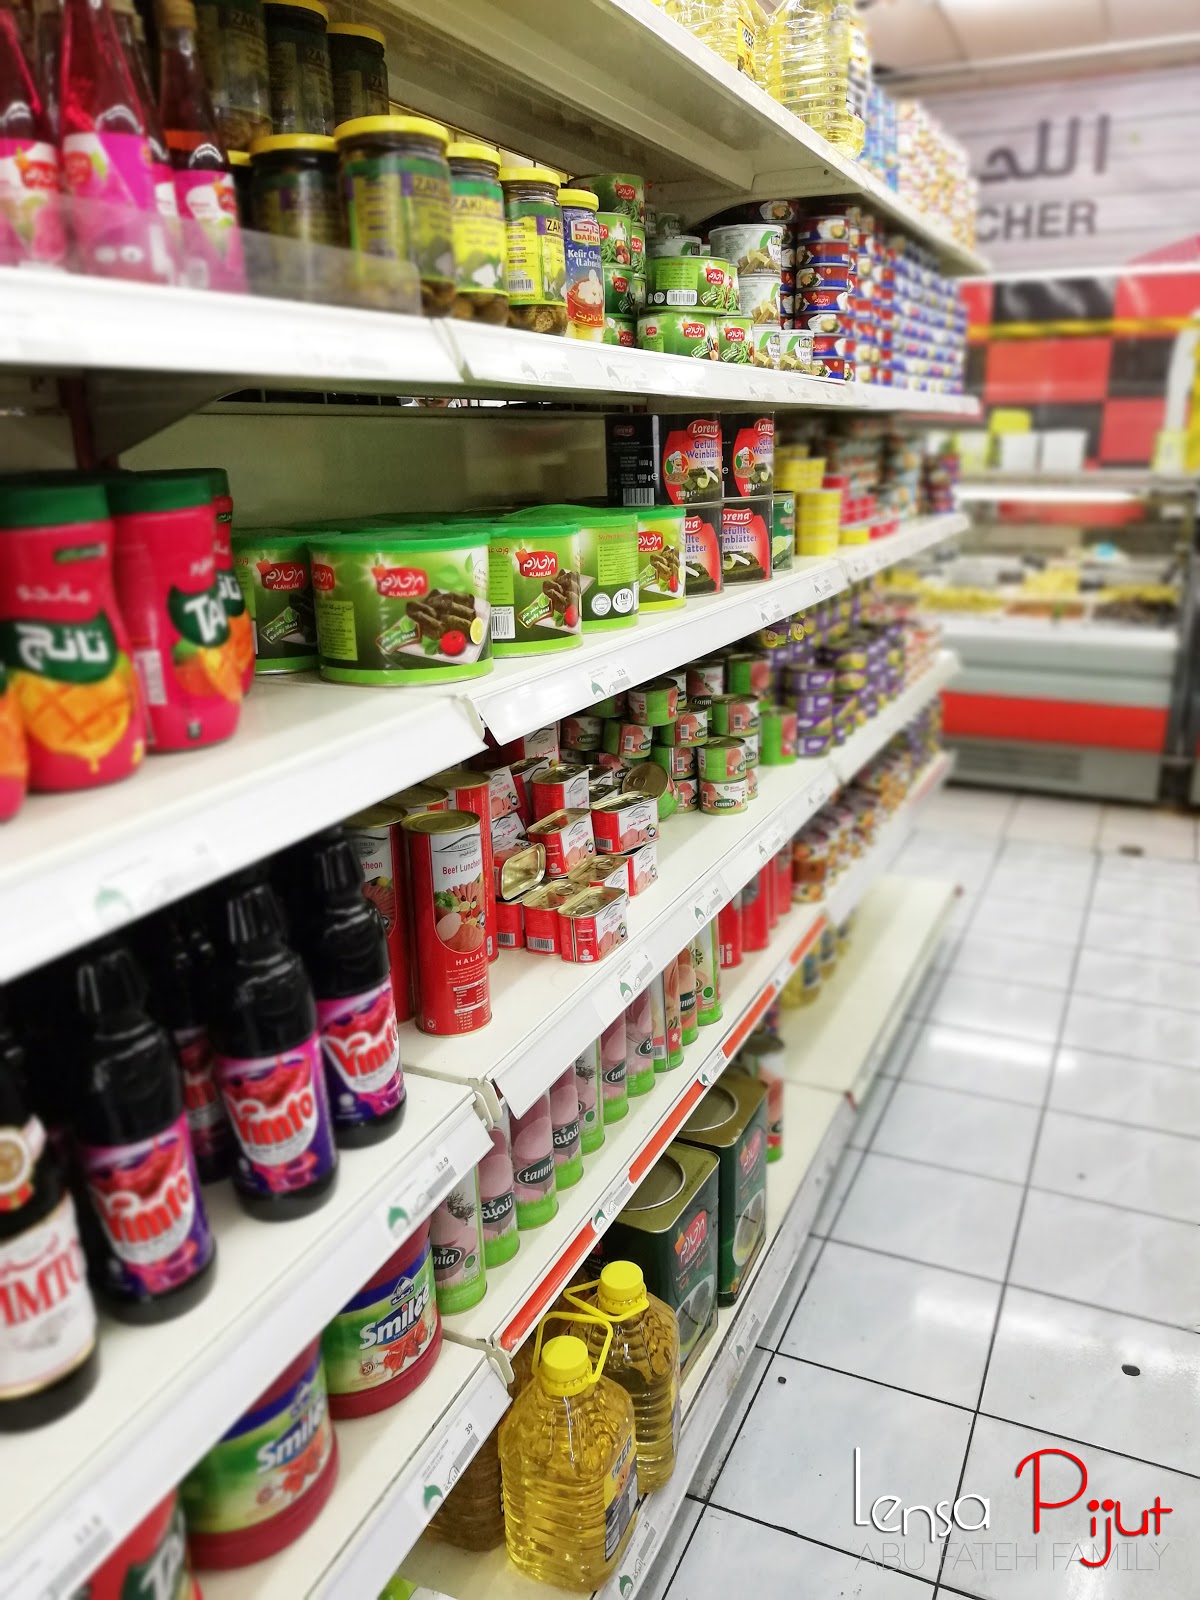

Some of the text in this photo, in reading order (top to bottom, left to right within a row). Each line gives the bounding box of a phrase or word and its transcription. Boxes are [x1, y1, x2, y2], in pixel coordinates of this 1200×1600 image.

[567, 248, 588, 259] Kefir
[272, 582, 300, 590] ALAHLAM
[525, 611, 540, 626] Ready
[269, 627, 286, 641] Ready
[442, 865, 458, 876] Beef
[455, 951, 484, 967] HALAL
[359, 1282, 430, 1351] Smilee
[363, 1364, 373, 1374] 20
[464, 1422, 474, 1435] 39
[643, 1521, 650, 1532] 35
